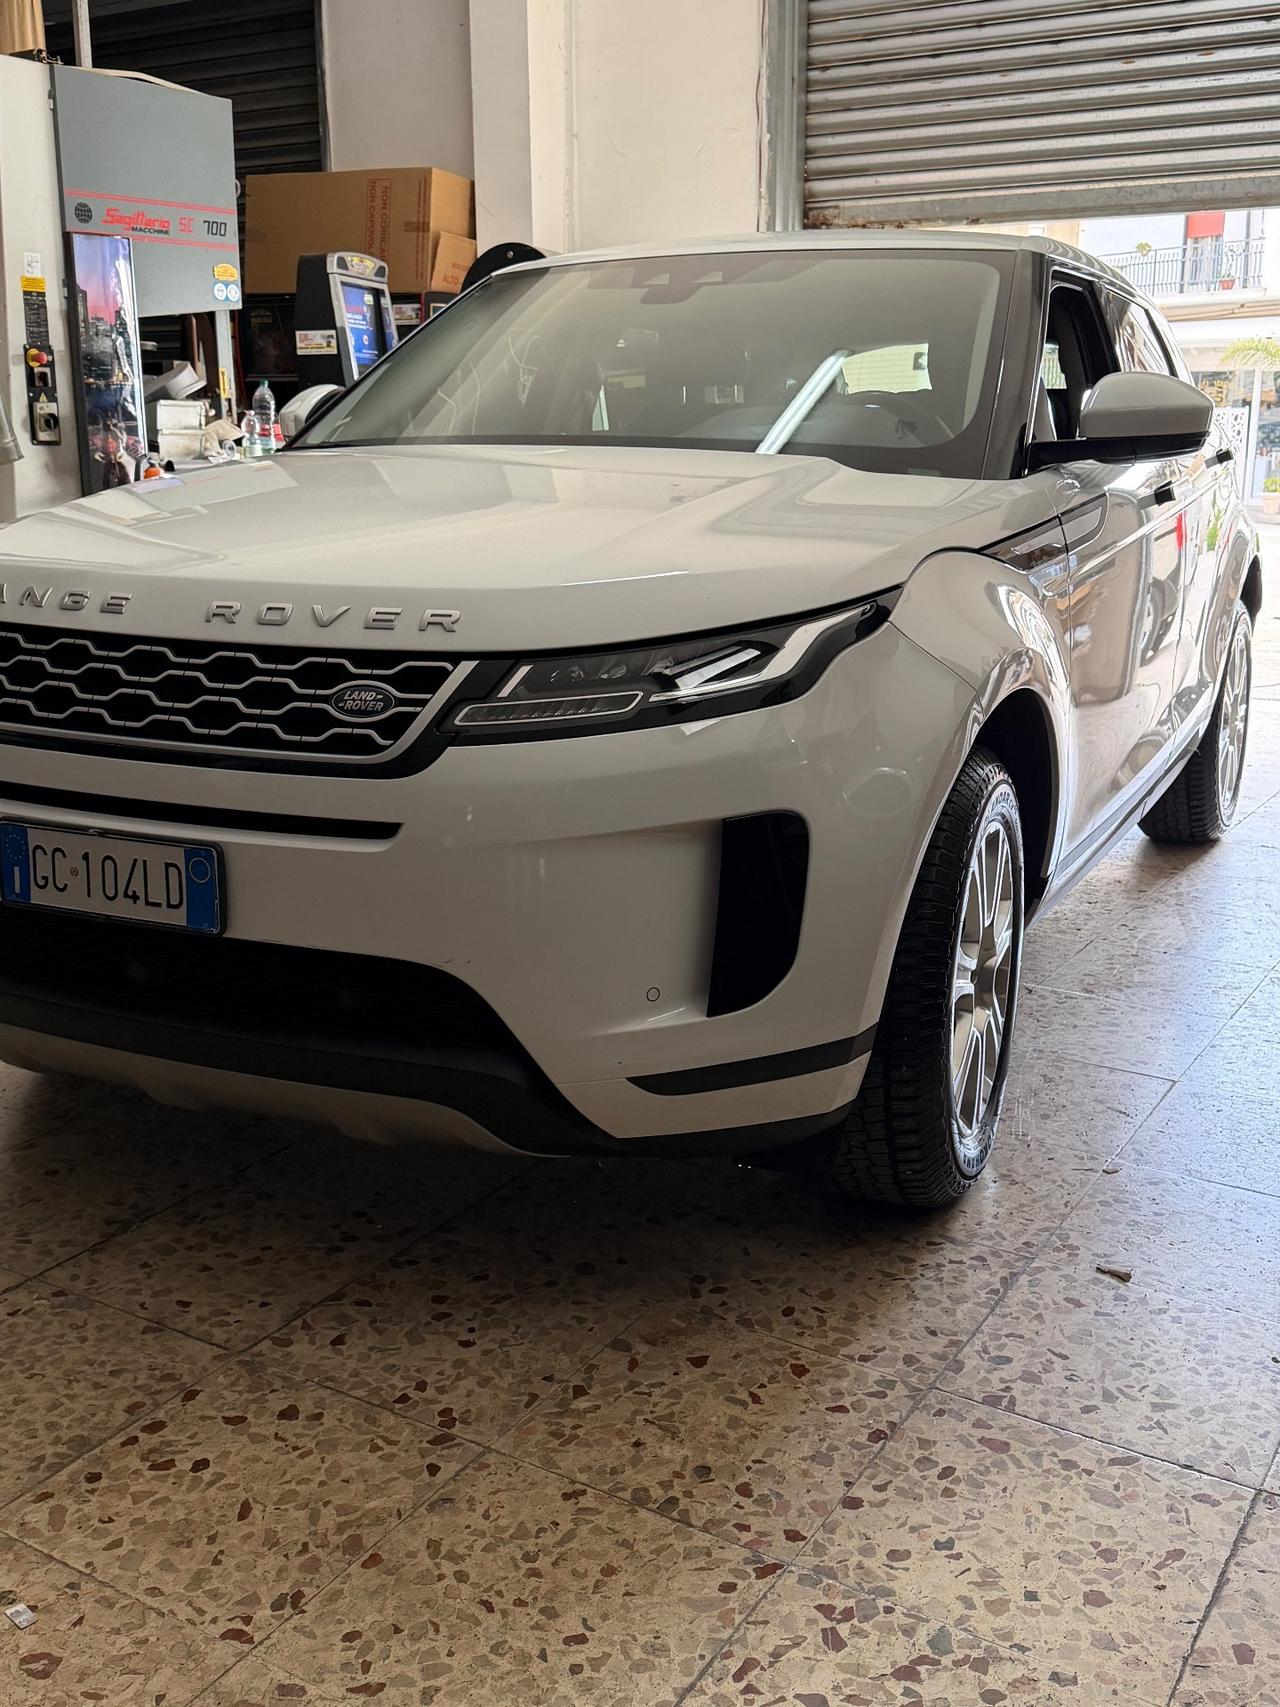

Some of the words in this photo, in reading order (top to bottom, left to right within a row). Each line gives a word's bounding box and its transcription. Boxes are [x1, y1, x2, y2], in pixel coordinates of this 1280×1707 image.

[101, 207, 170, 230] Sagittario
[178, 216, 195, 233] SC
[203, 219, 227, 237] 700
[131, 226, 170, 235] MACCHINE
[205, 600, 461, 633] ROVER
[343, 690, 377, 701] LAND
[344, 700, 384, 712] ROVER
